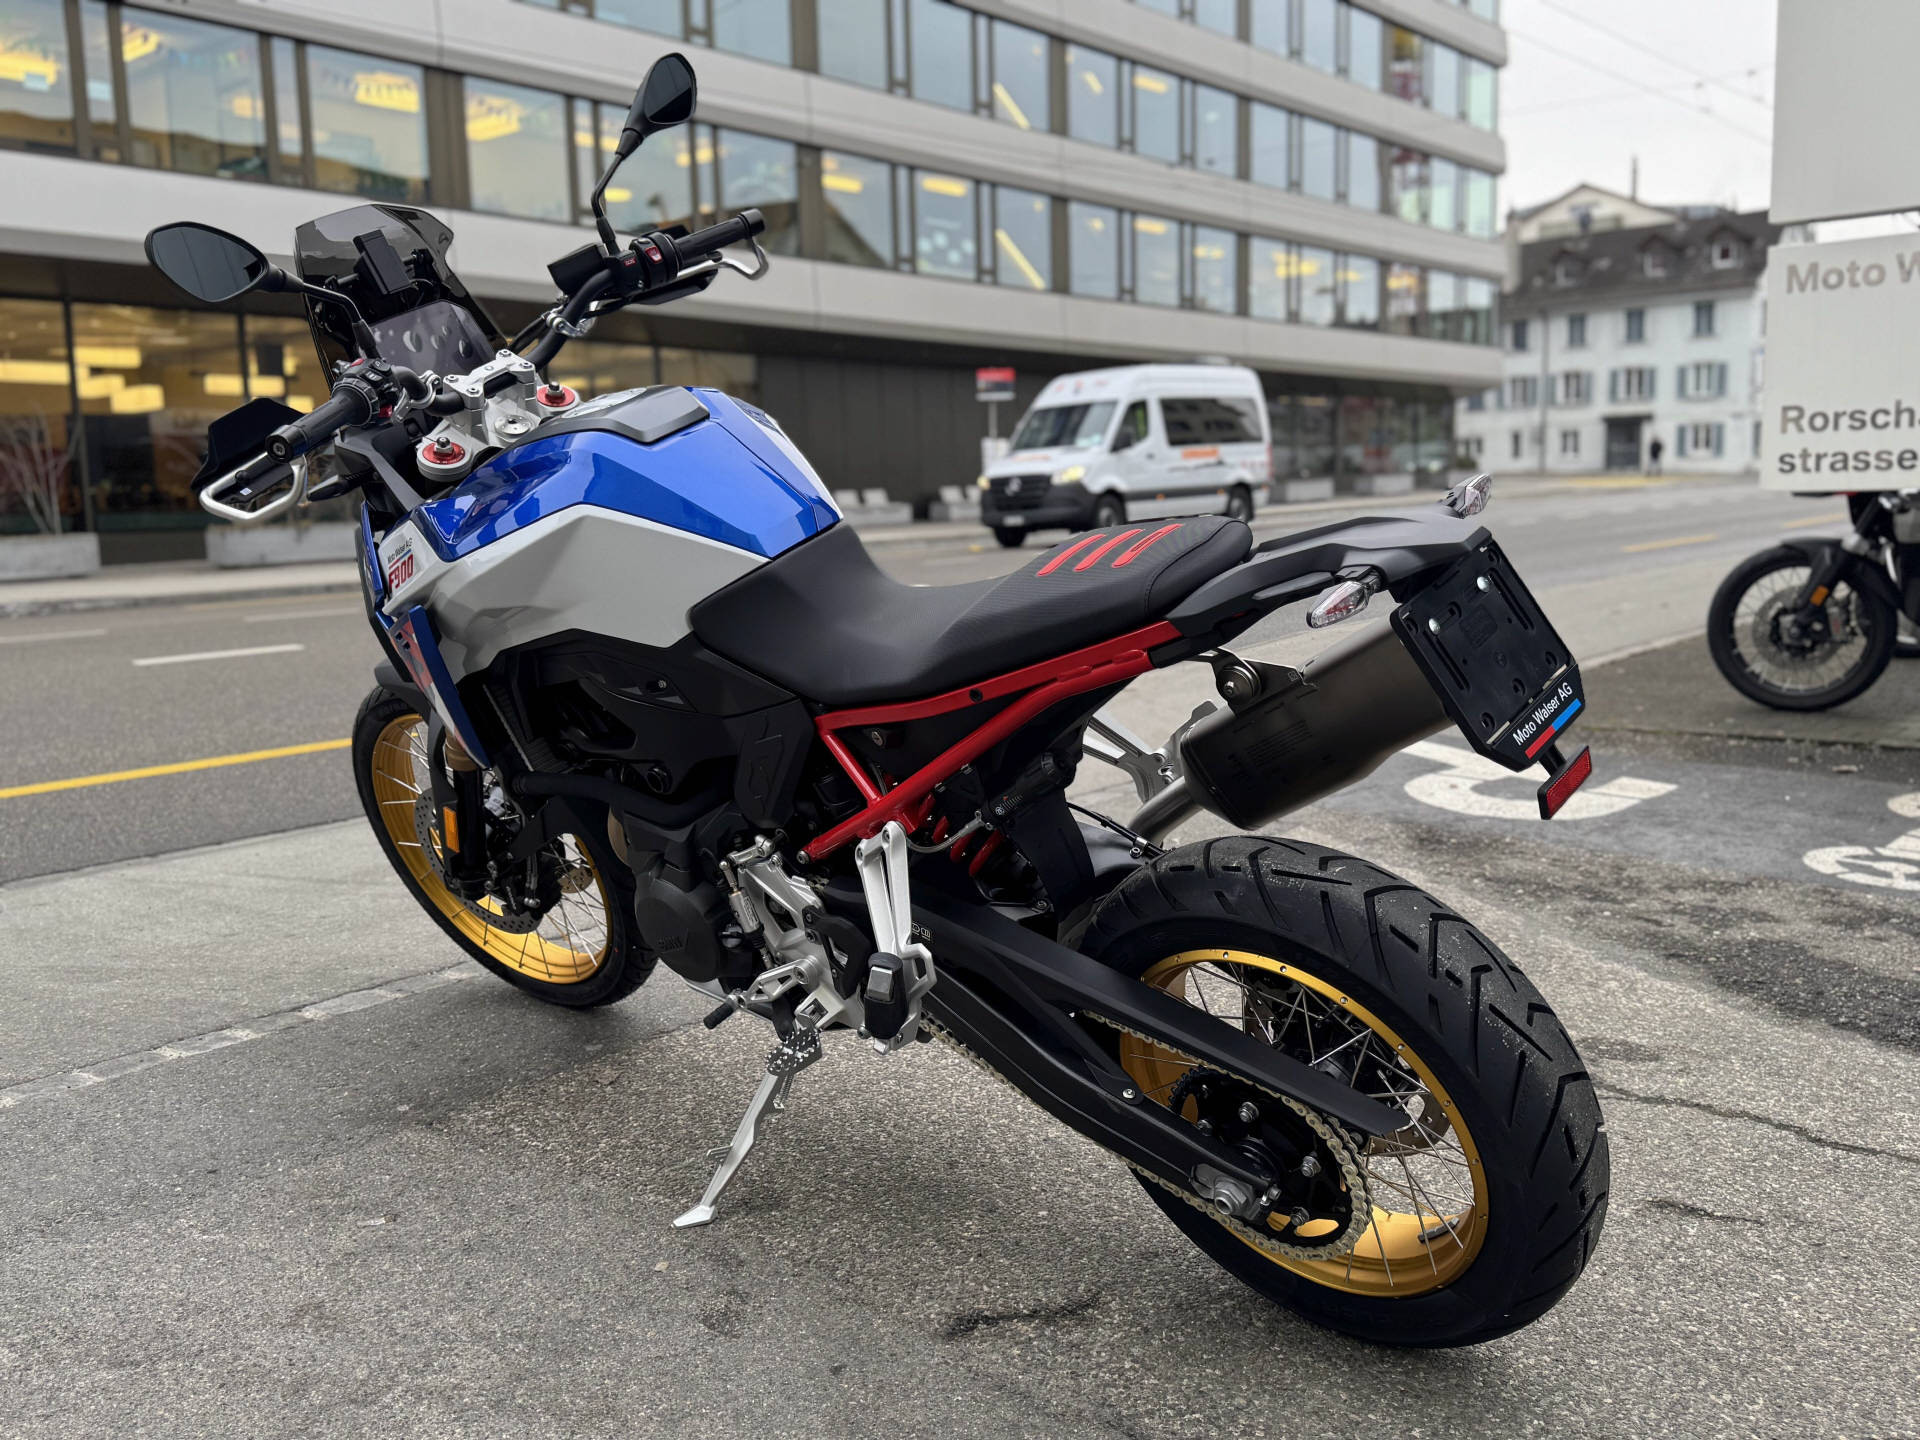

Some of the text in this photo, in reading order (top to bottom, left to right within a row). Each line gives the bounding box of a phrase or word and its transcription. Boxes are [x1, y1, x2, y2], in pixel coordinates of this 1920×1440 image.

[1786, 261, 1886, 294] Moto
[1780, 399, 1920, 434] Rorsch
[1778, 449, 1918, 473] strasse
[389, 554, 414, 594] F900
[1512, 682, 1573, 746] Moto Walser AG
